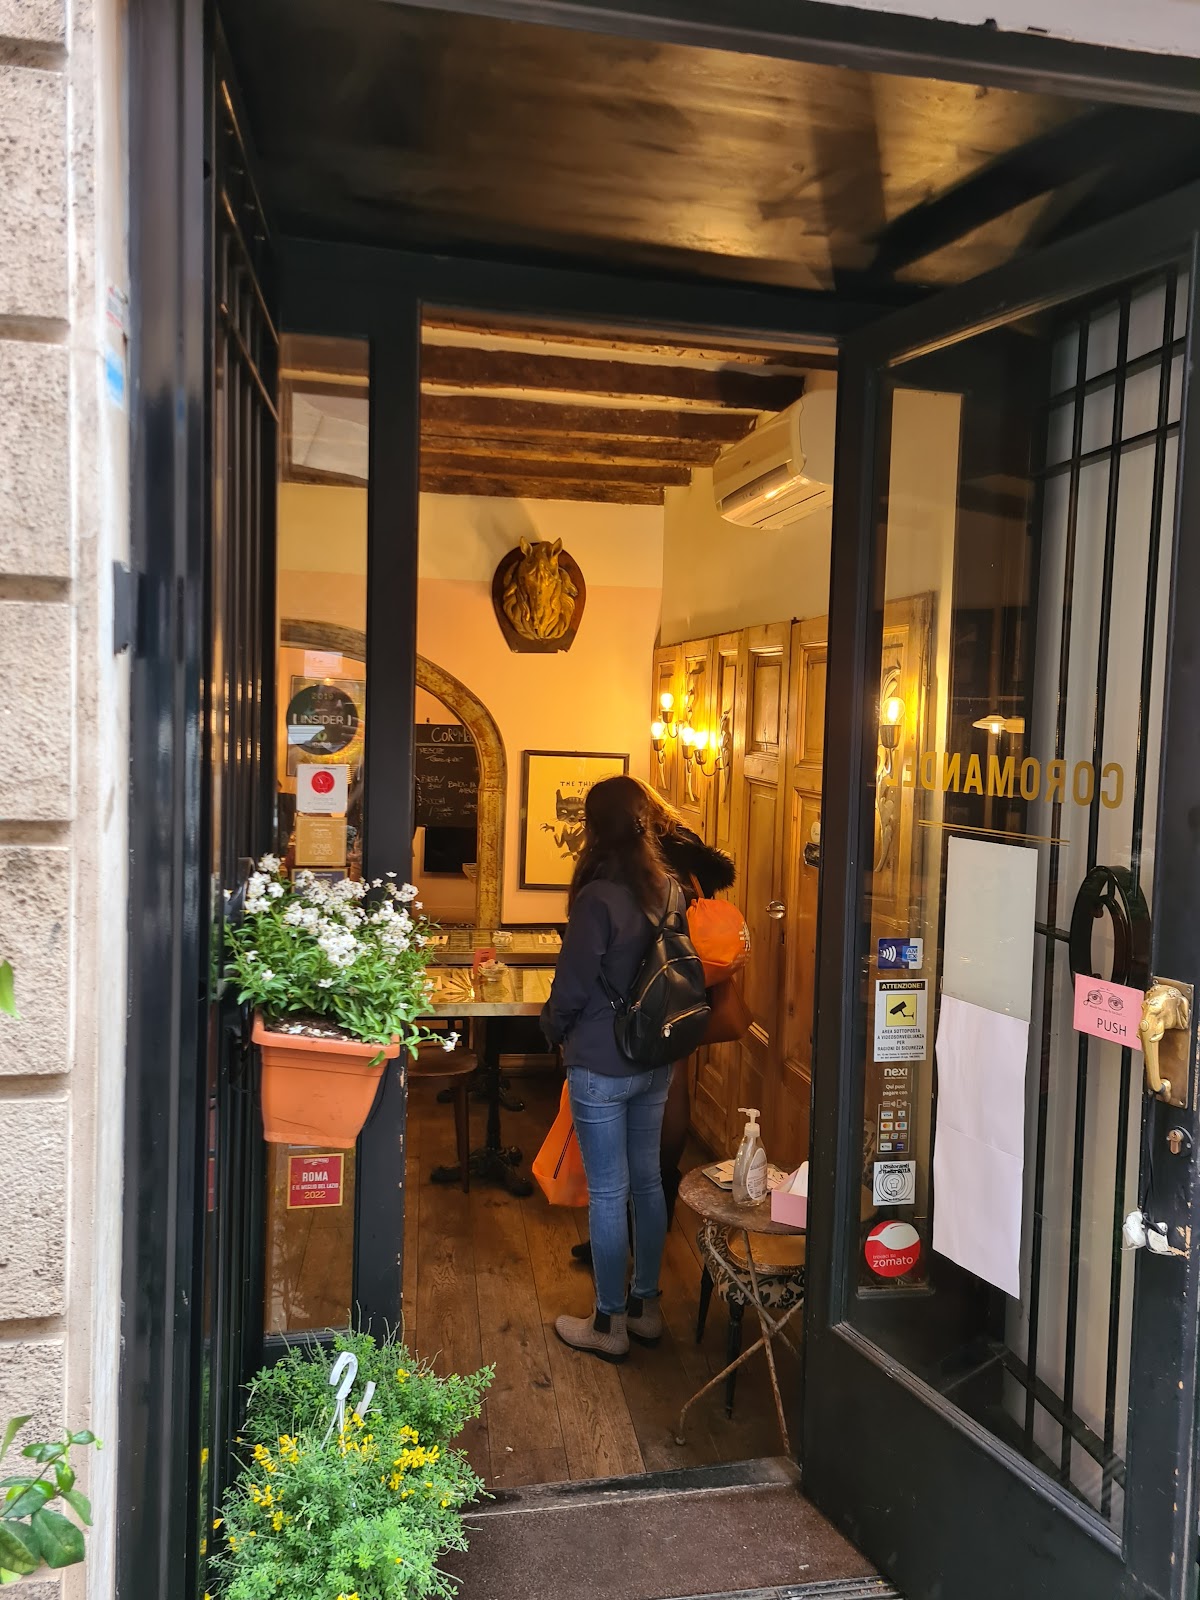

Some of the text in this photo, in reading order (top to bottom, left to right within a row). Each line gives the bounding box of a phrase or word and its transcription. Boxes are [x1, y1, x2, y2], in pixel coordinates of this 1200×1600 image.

[300, 714, 344, 725] INSIDER
[1096, 1017, 1127, 1037] PUSH
[884, 1068, 908, 1076] nexi
[302, 1171, 328, 1181] ROMA
[873, 1256, 914, 1268] zomato
